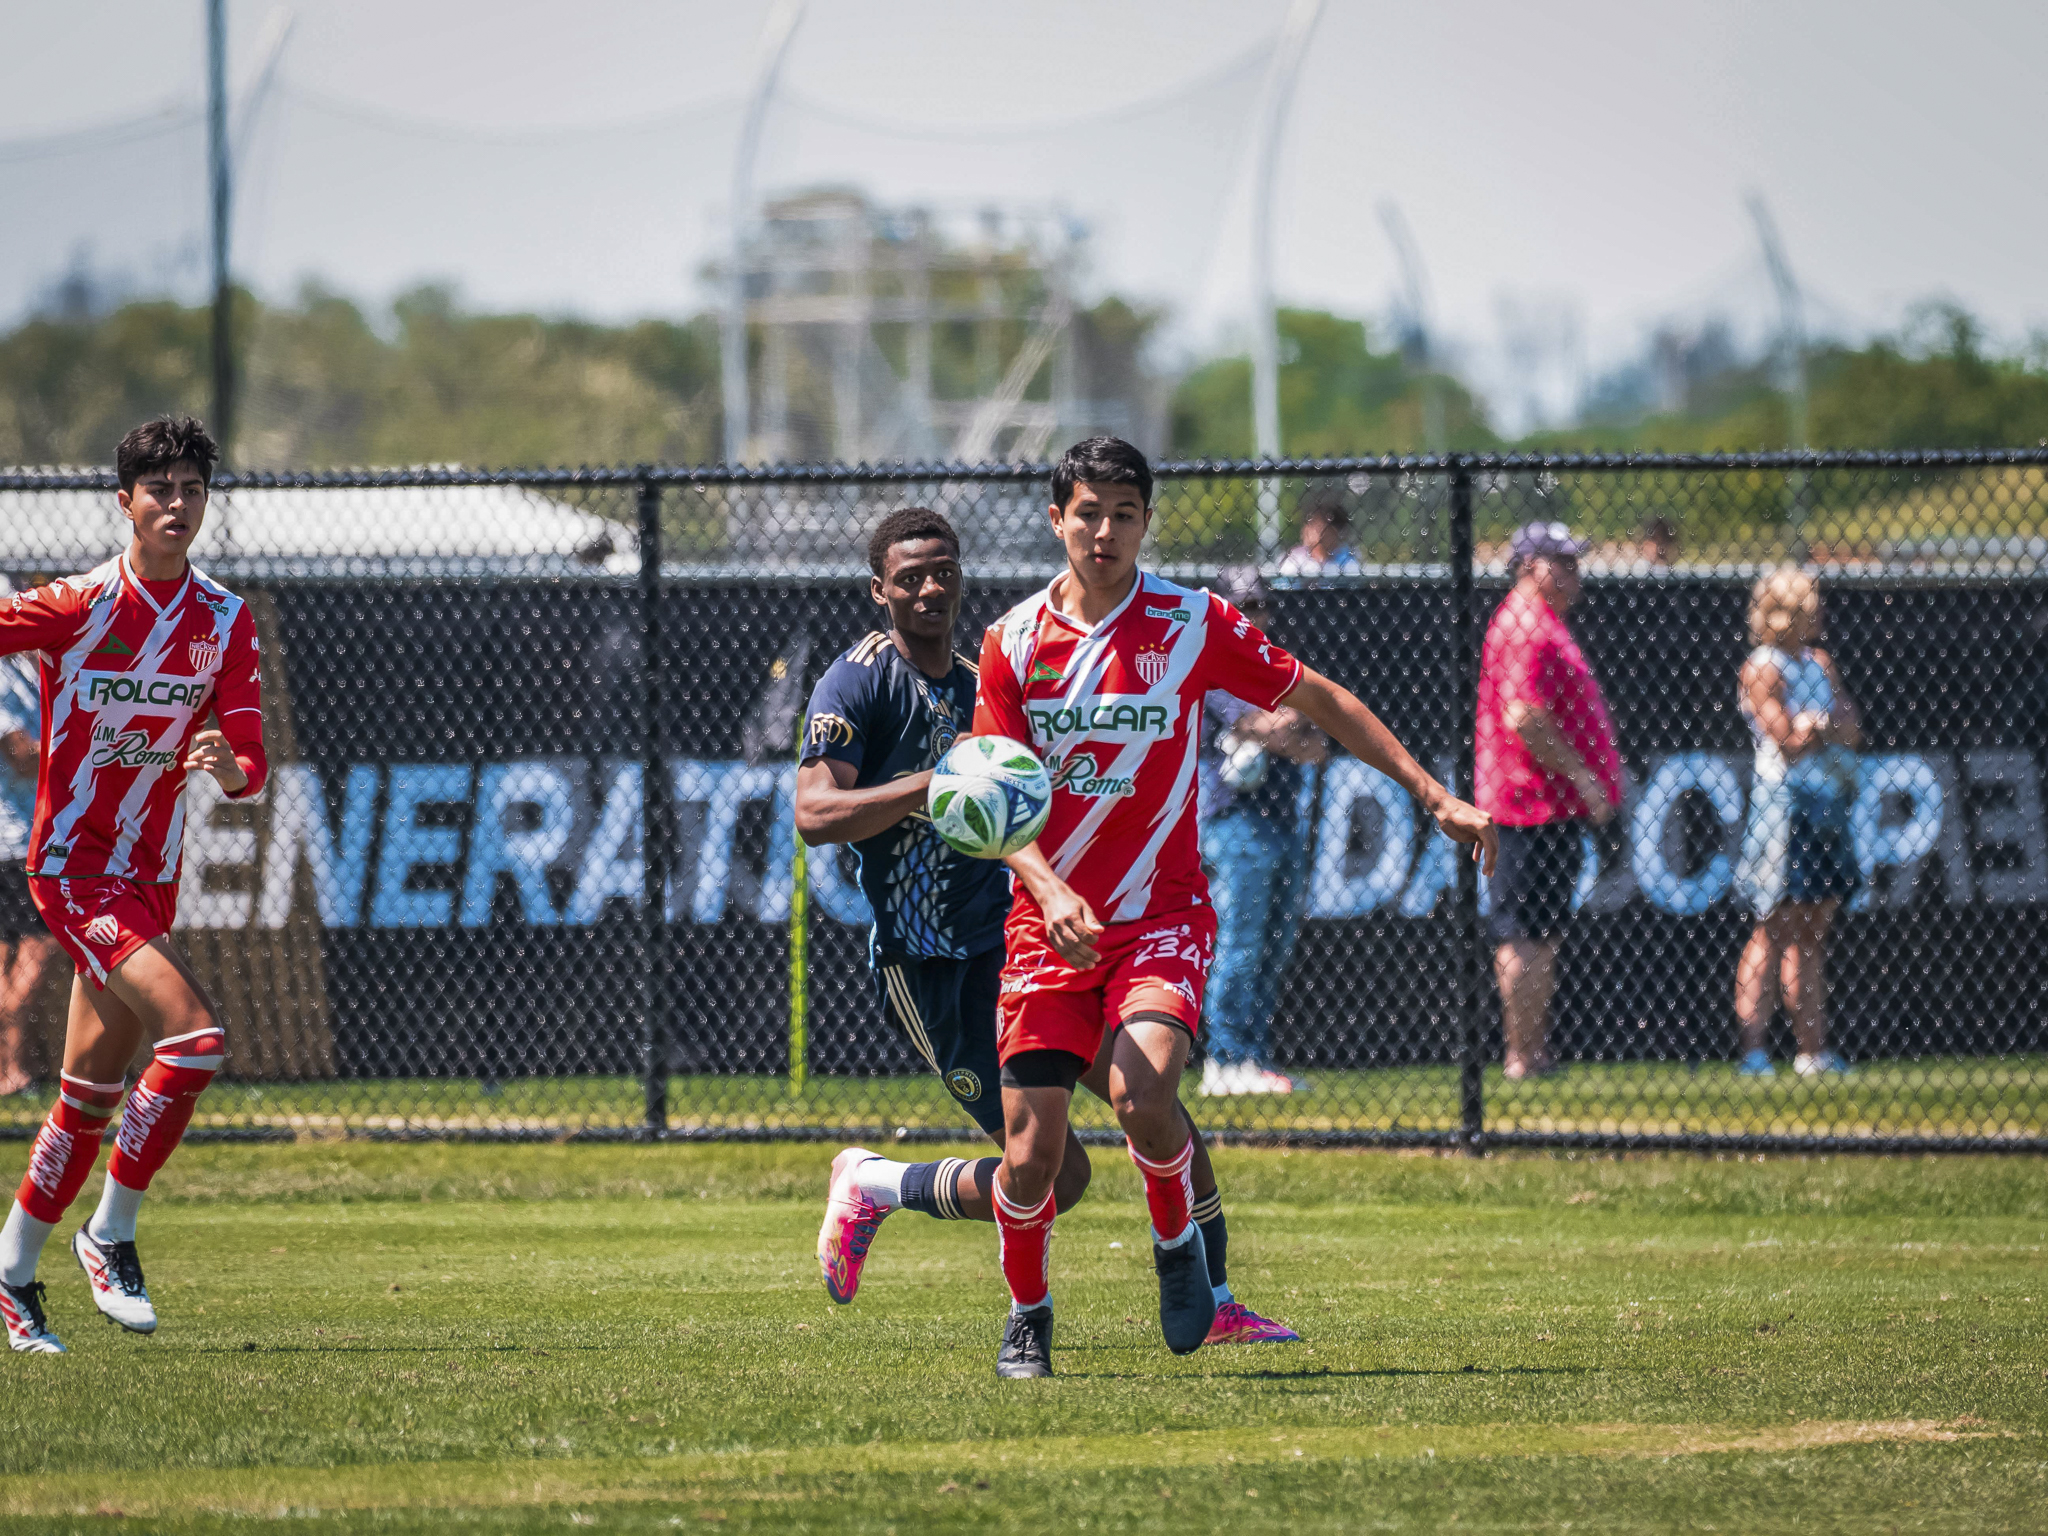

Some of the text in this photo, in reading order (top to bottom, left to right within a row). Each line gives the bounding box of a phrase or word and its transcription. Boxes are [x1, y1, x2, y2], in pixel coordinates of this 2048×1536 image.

[1147, 607, 1191, 622] brandme
[89, 678, 206, 709] ROLCAR
[94, 726, 116, 742] J.M.
[1029, 704, 1168, 741] ROLCAR
[92, 731, 175, 766] Romo
[117, 1082, 173, 1162] PERDURA
[29, 1115, 74, 1198] PERDURA
